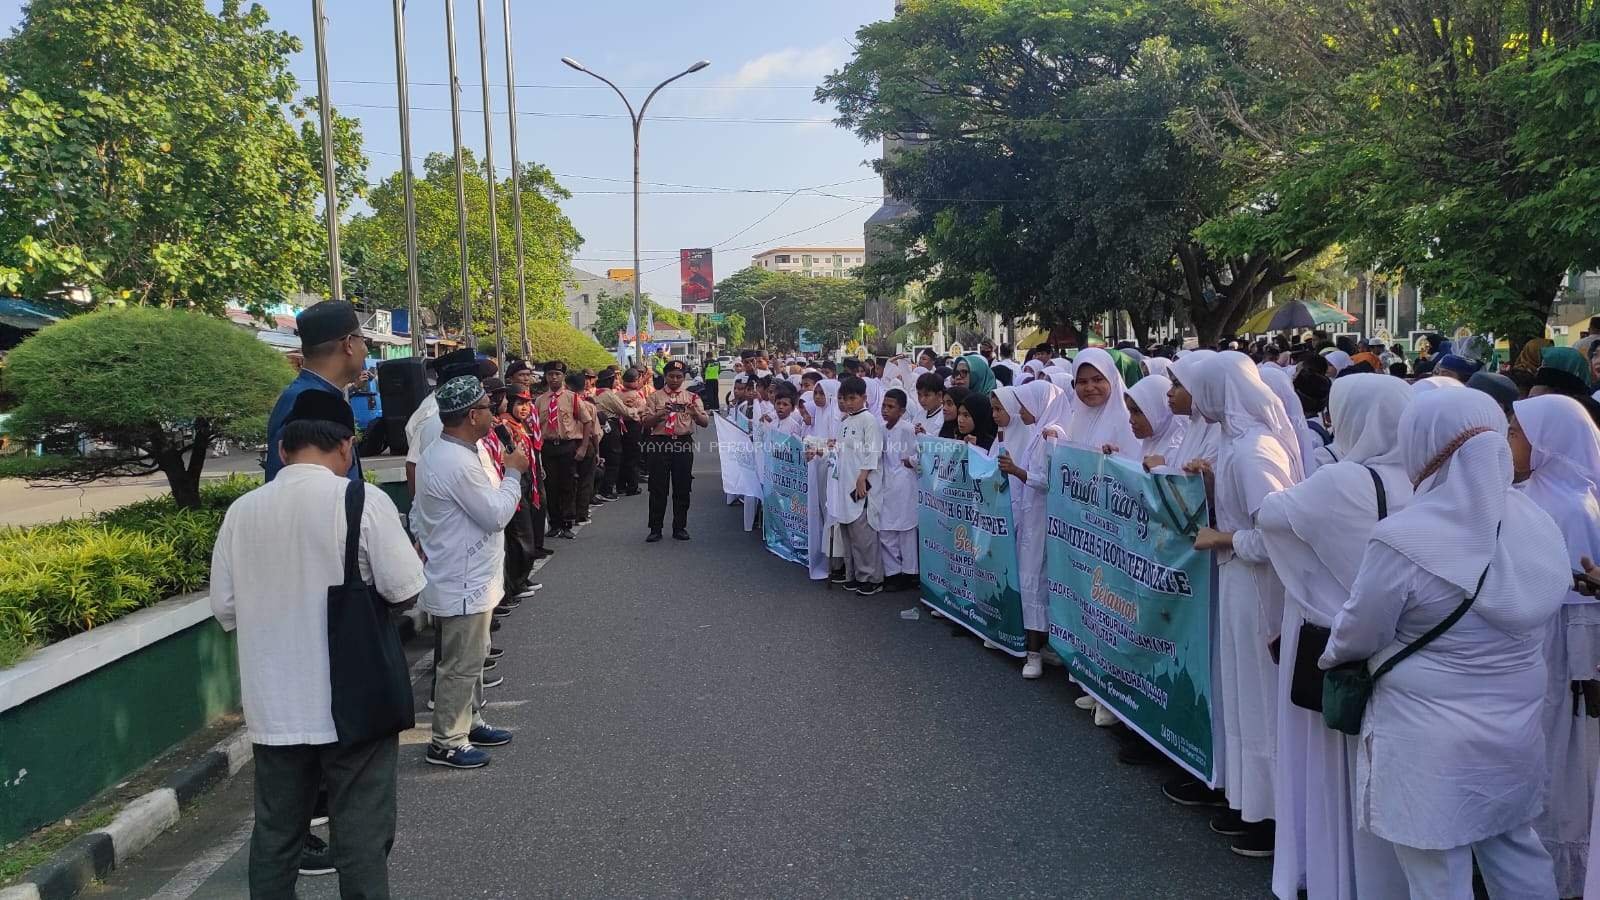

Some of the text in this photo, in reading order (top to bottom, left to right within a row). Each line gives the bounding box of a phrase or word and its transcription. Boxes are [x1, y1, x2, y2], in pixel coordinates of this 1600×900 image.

[956, 502, 963, 520] 6
[1047, 516, 1095, 557] ISLAMIYAH
[1094, 536, 1102, 559] 5
[1126, 550, 1193, 597] TERNATE
